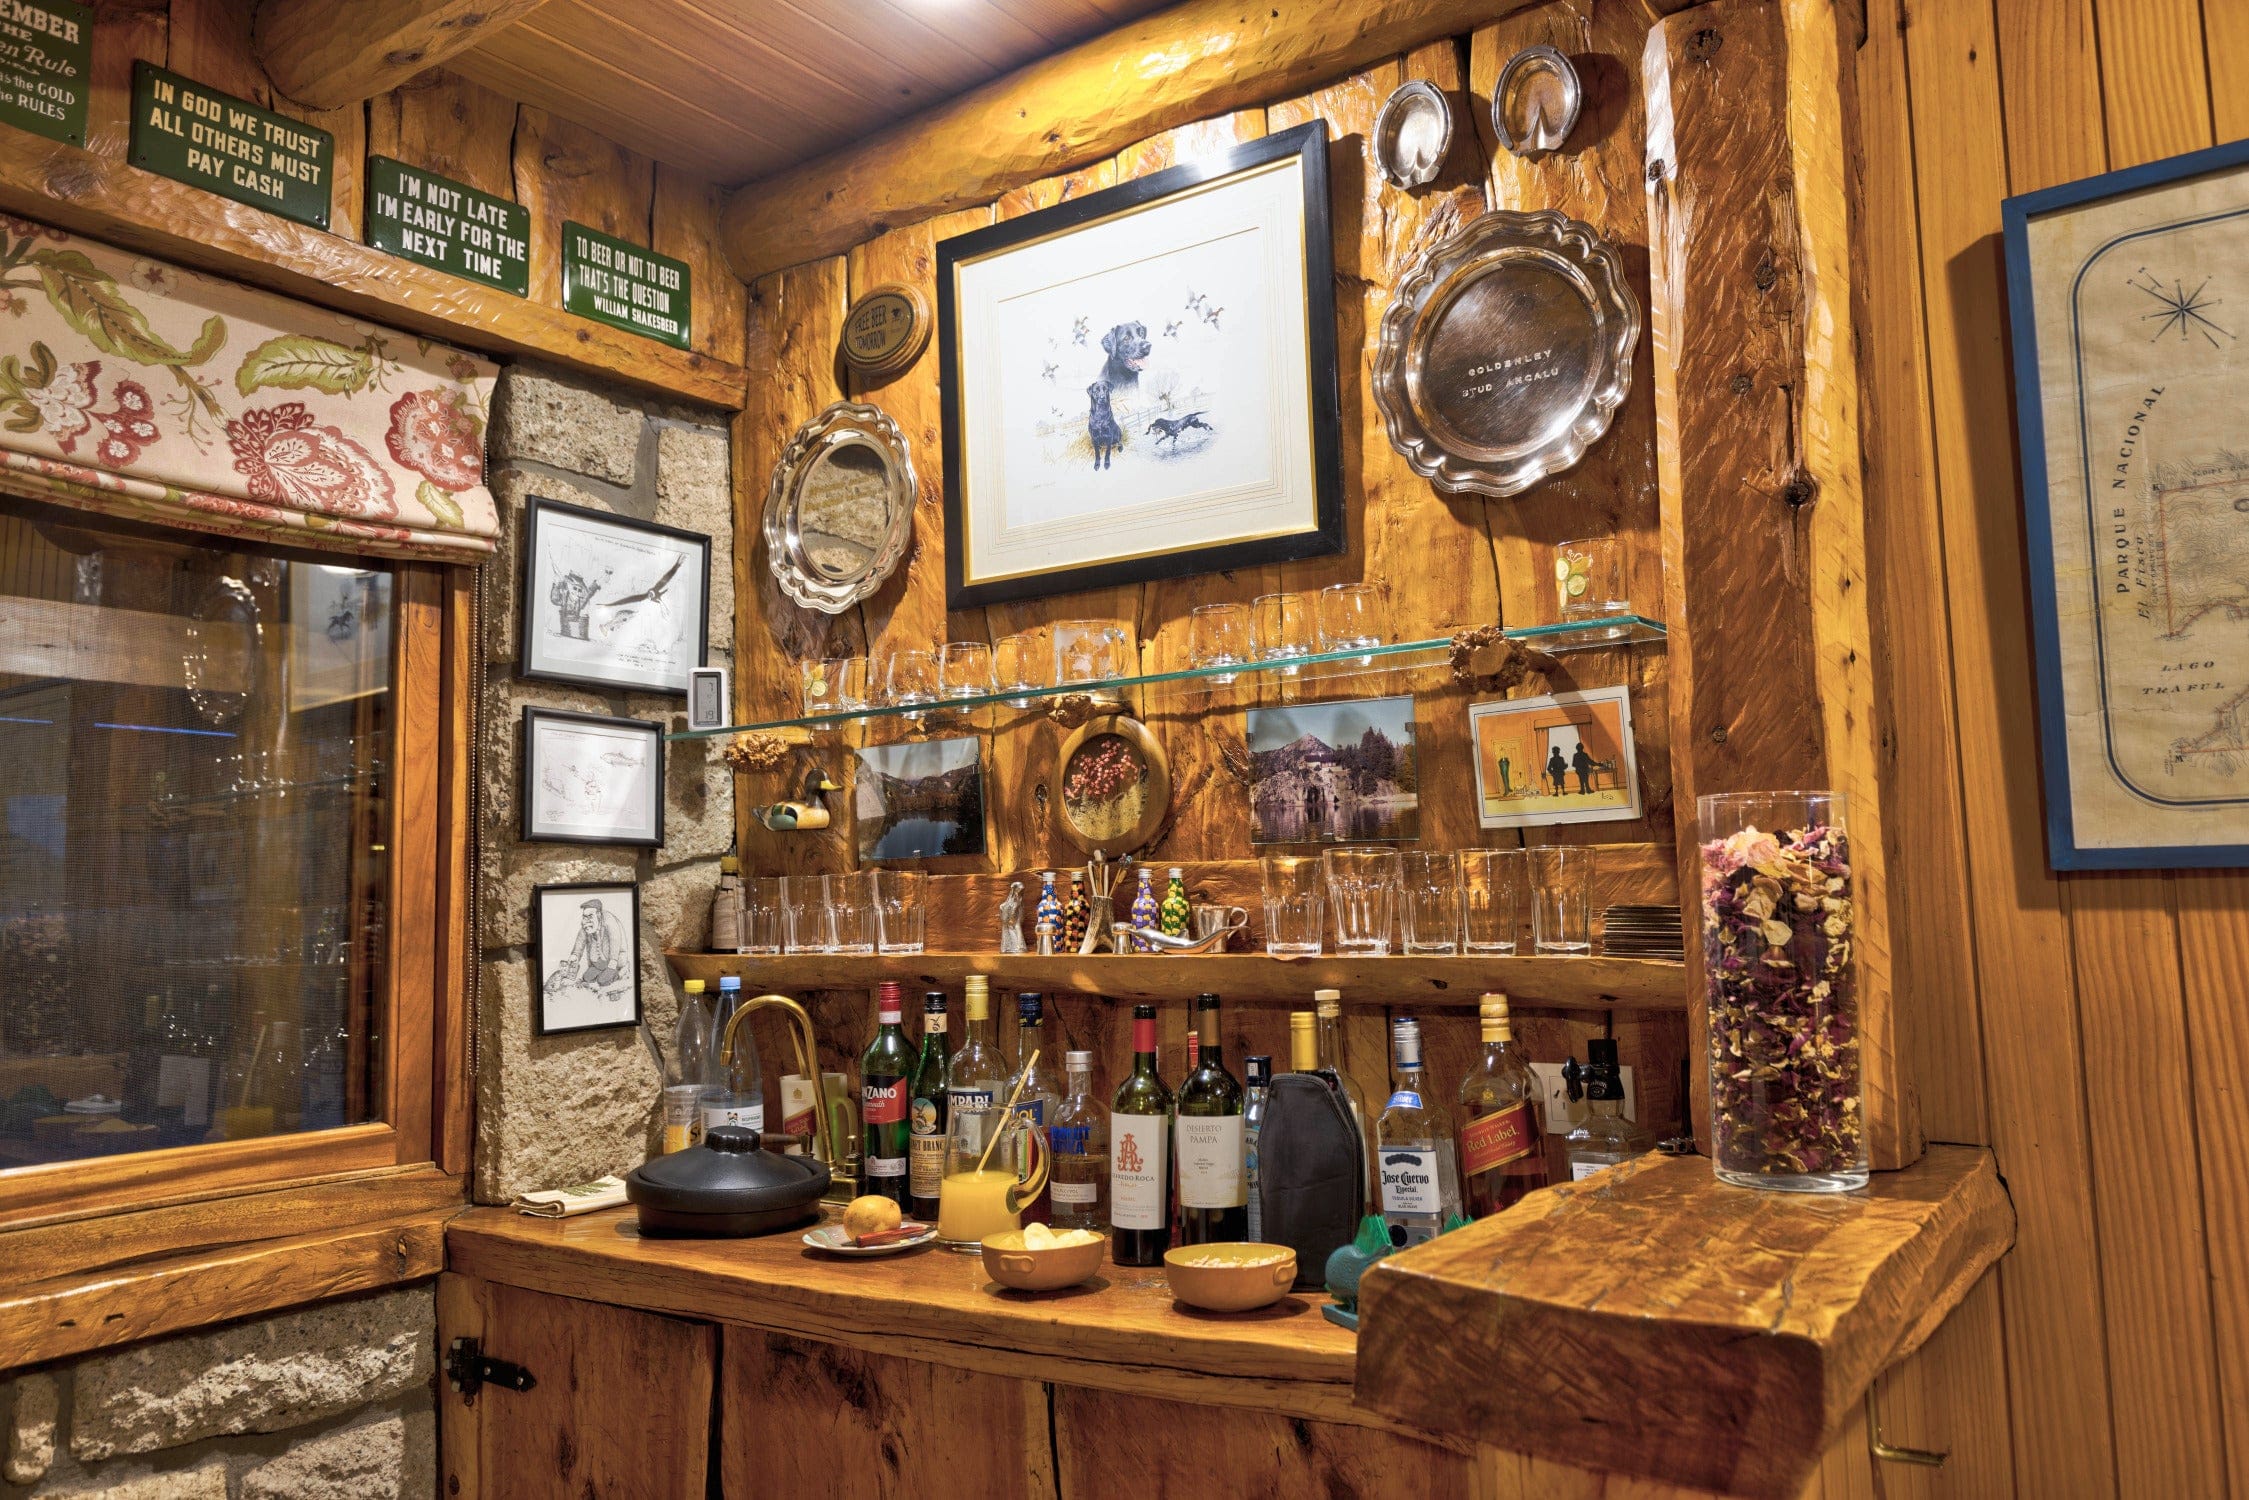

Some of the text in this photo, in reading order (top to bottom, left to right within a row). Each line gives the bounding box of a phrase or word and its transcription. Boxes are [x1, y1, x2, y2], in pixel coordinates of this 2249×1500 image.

[0, 22, 32, 42] HE
[24, 45, 77, 77] Rule
[13, 75, 34, 91] the
[37, 82, 75, 105] GOLD
[18, 94, 65, 120] RULES
[154, 79, 320, 159] IN GOD WE TRUST
[150, 107, 321, 185] ALL OTHERS MUST
[187, 148, 284, 200] PAY CASH
[400, 173, 508, 230] I'M NOT LATE
[377, 192, 526, 262] I'M EARLY FOR THE
[402, 227, 502, 280] NEXT TIME
[576, 236, 680, 291] TO BEER OR NOT TO BEER
[579, 263, 670, 314] THAT'S THE QUESTION
[594, 295, 678, 336] WILLIAM SHAKESBEER
[2112, 386, 2166, 594] PARQUE NACIONAL
[2161, 661, 2215, 672] LAGO
[948, 1095, 990, 1109] MPARI
[1186, 1124, 1222, 1133] DESIERTO
[1190, 1135, 1218, 1144] PAMPA
[1466, 1135, 1487, 1152] Red
[1135, 1174, 1155, 1182] ROCA
[1382, 1170, 1429, 1185] Jose Cuervo
